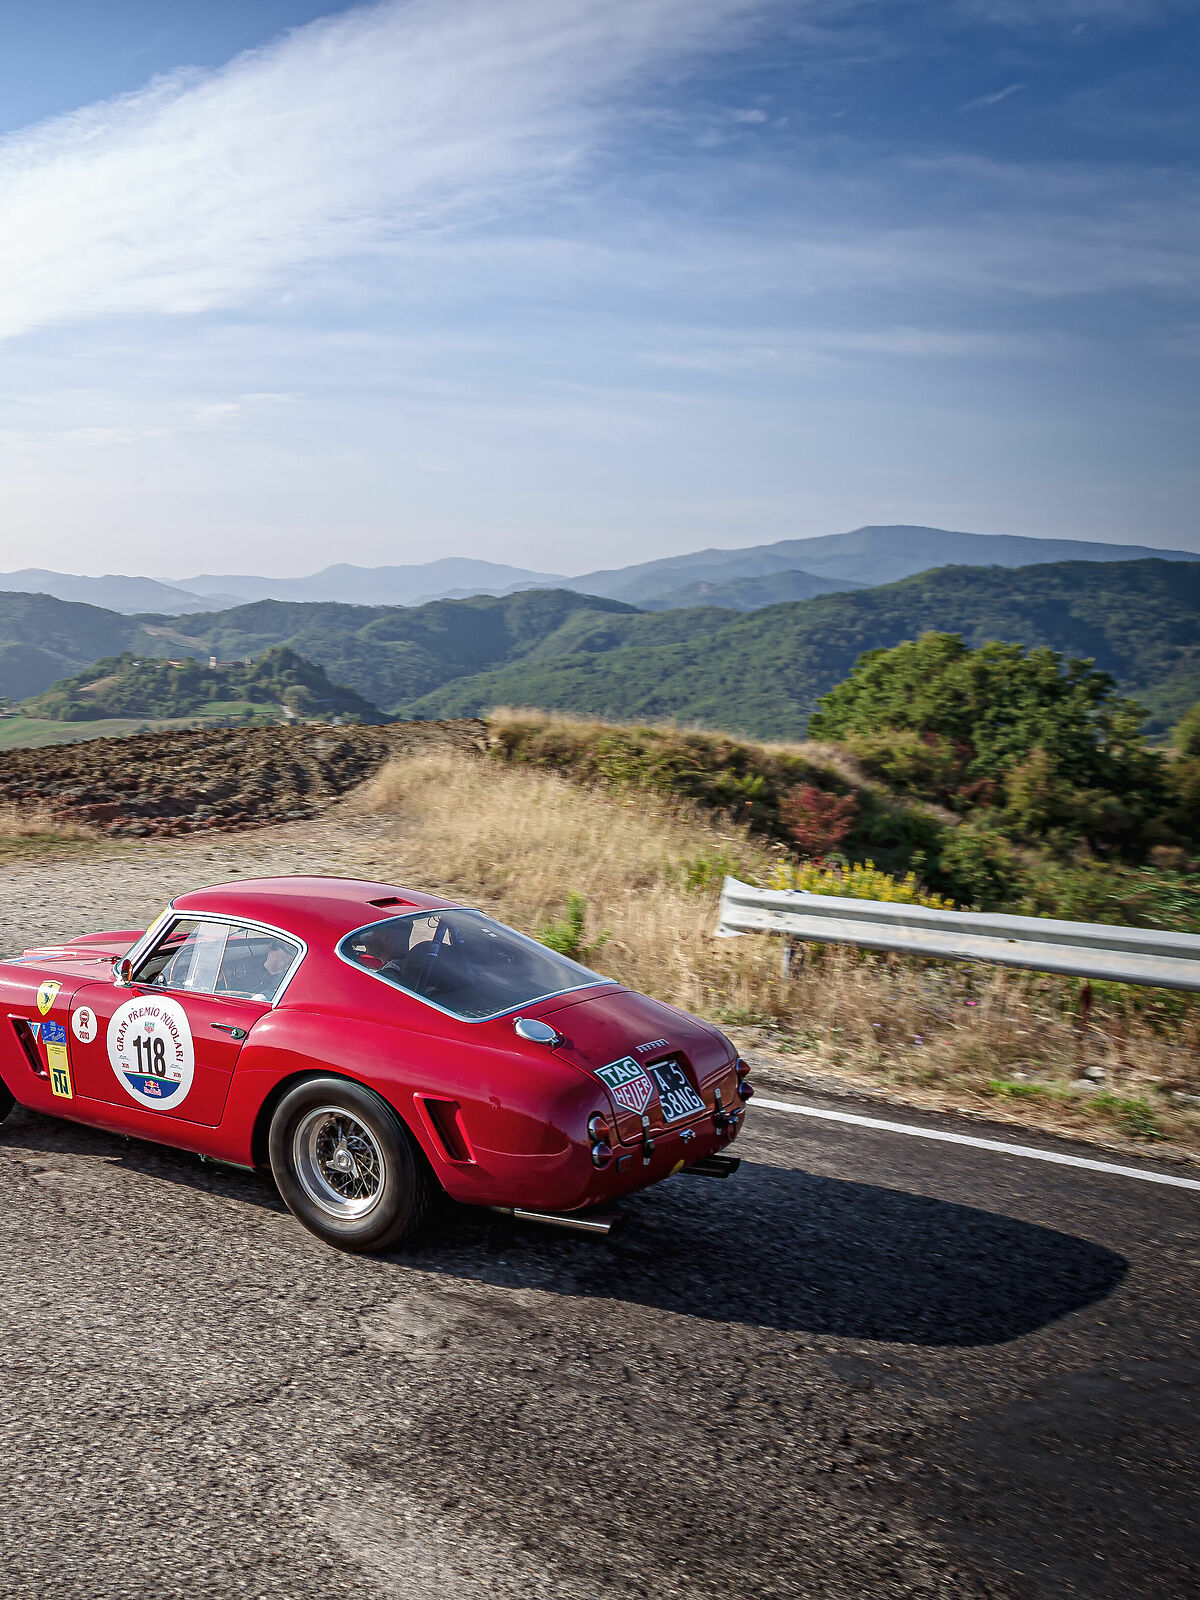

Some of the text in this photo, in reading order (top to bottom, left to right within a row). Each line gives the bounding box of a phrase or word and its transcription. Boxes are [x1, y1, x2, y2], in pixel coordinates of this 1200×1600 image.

[116, 1006, 184, 1063] GRAN PREMIO NUVOLARI
[132, 1035, 166, 1077] 118
[600, 1060, 640, 1084] TAG
[653, 1062, 686, 1092] A 5
[614, 1078, 650, 1110] HEUER
[659, 1085, 701, 1118] 58NG
